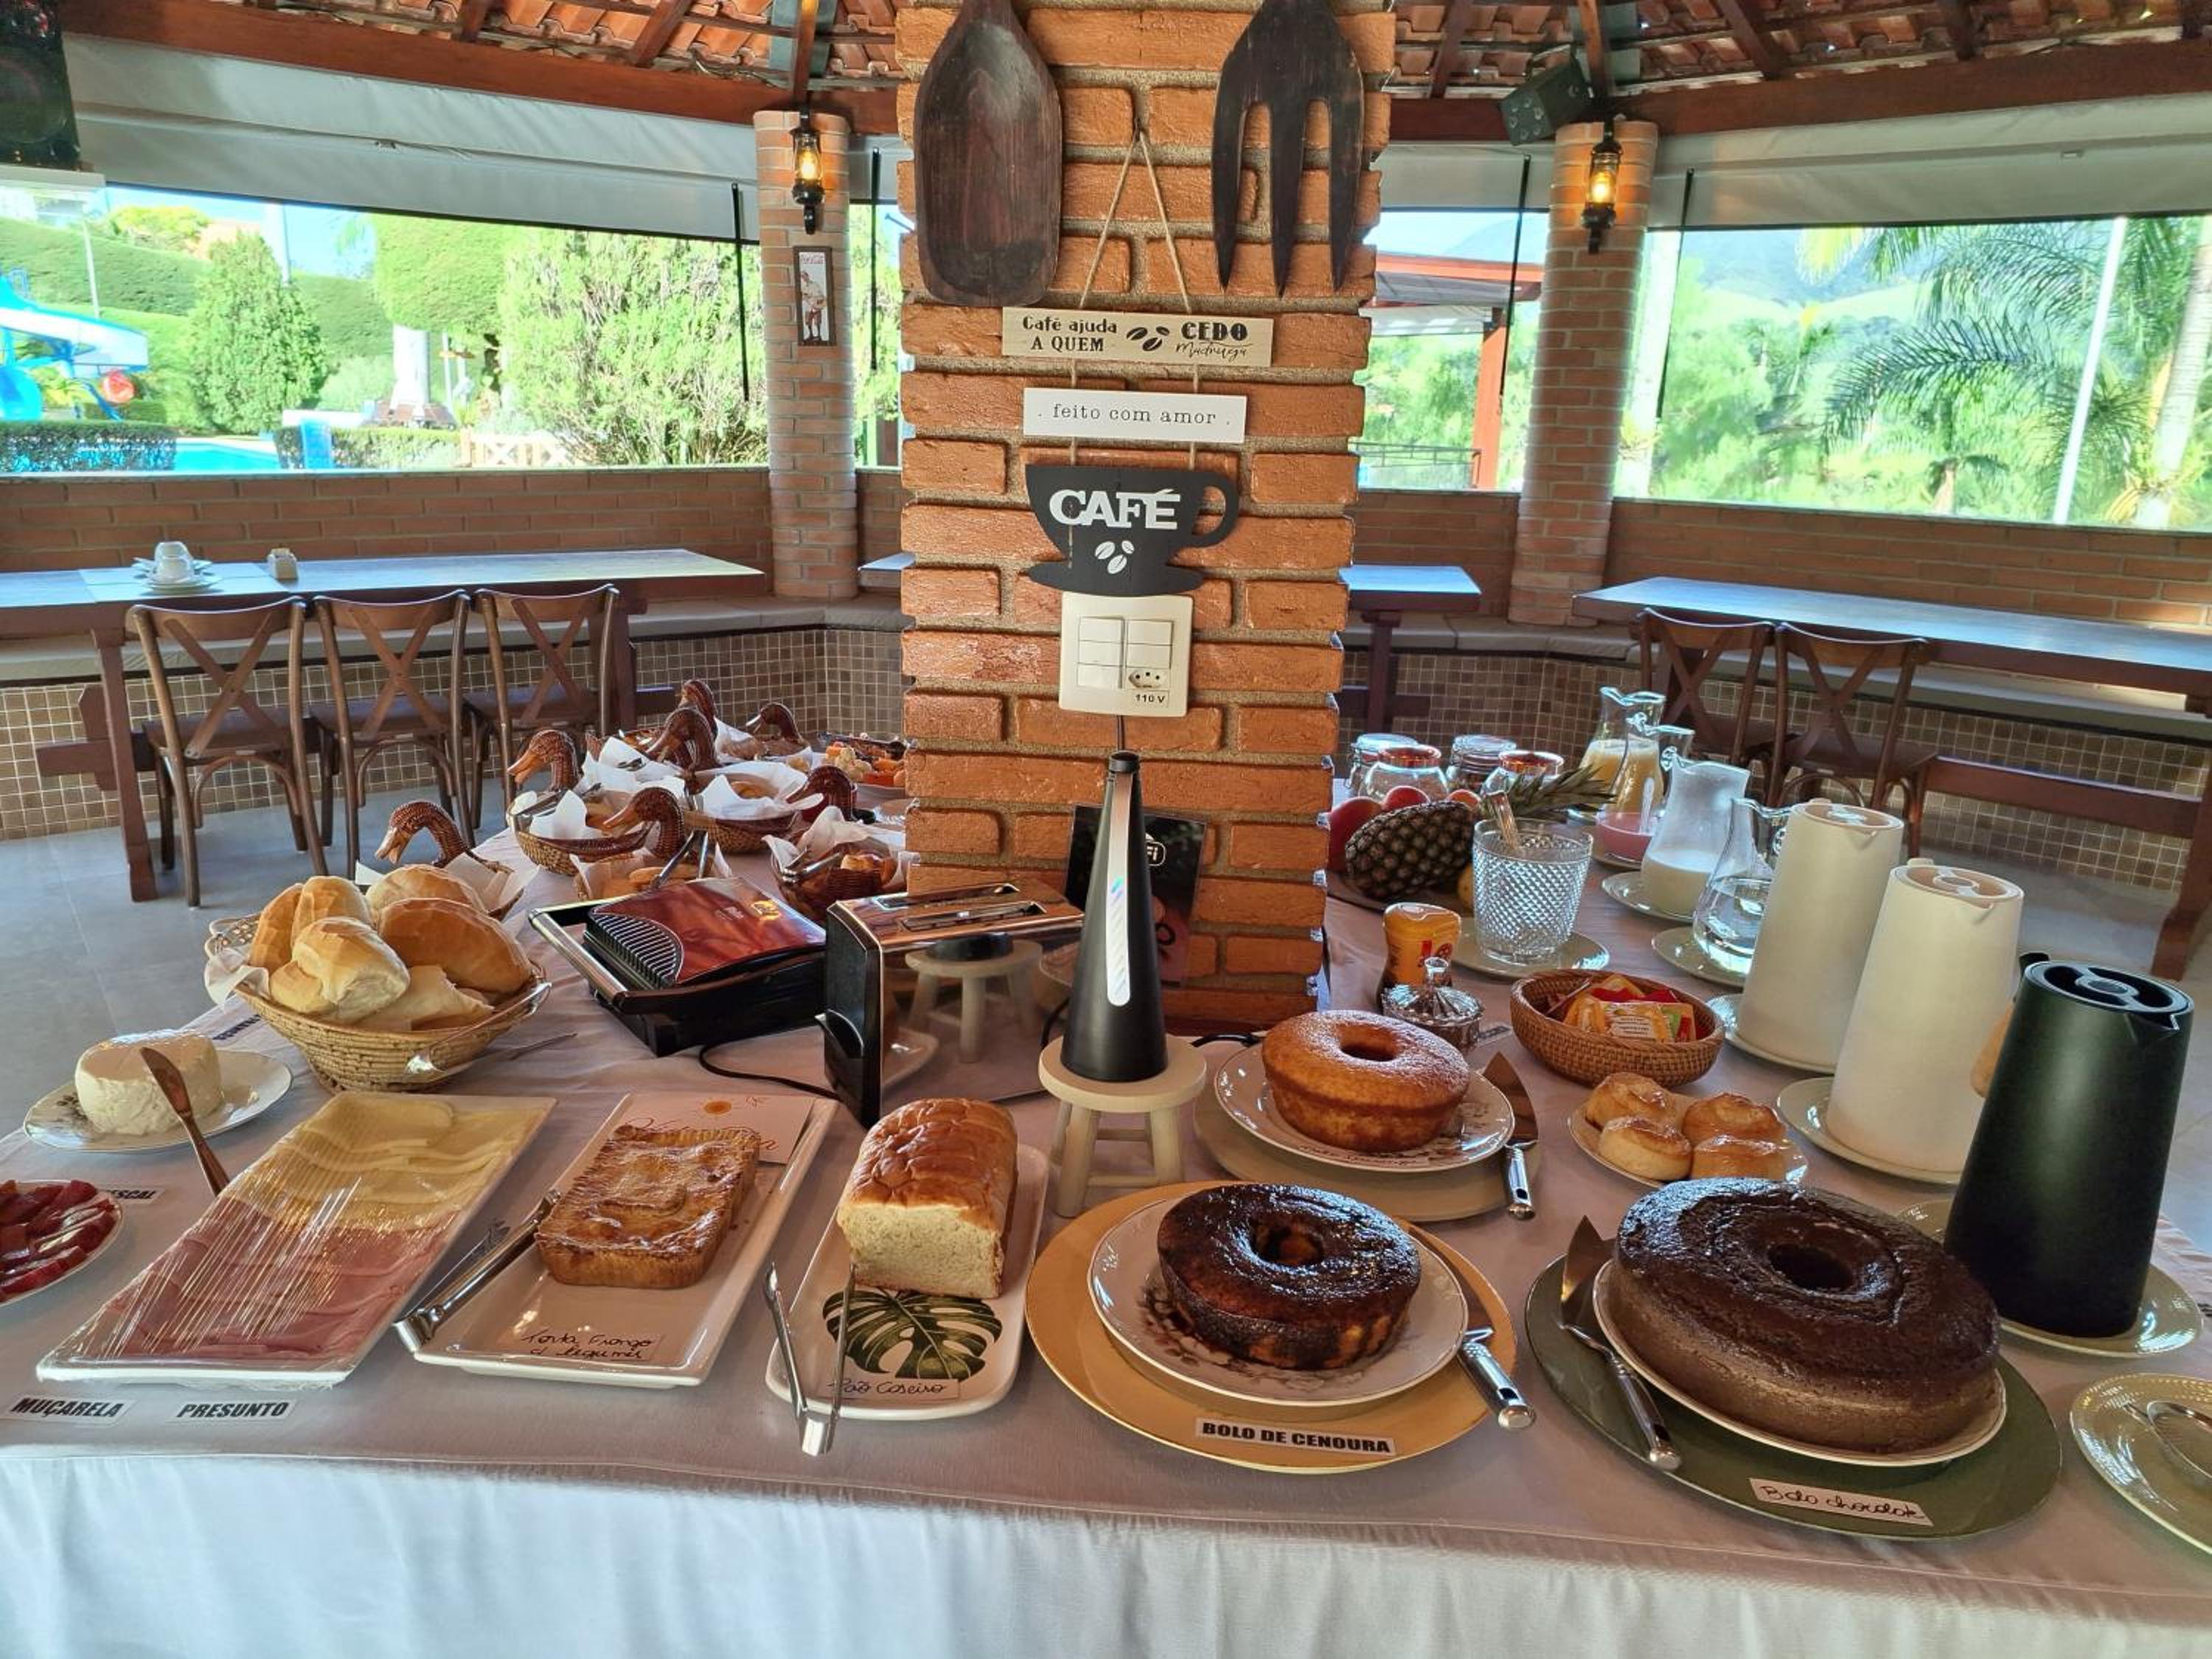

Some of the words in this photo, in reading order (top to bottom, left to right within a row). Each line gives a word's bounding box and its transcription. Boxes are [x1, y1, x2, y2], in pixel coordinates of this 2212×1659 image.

[1023, 316, 1062, 332] Café
[1068, 319, 1117, 335] ajuda
[1181, 321, 1248, 341] CEDO
[1032, 336, 1043, 350] A
[1051, 336, 1105, 352] QUEM
[1052, 403, 1101, 420] feito
[1109, 408, 1151, 422] com
[1160, 412, 1217, 425] amor
[1048, 488, 1181, 530] CAFÉ
[106, 1189, 157, 1200] ESCAL
[11, 1397, 125, 1419] MUÇARELA
[176, 1401, 290, 1418] PRESUNTO
[1203, 1422, 1254, 1439] BOLO
[1260, 1429, 1287, 1444] DE
[1291, 1433, 1391, 1453] CENOURA
